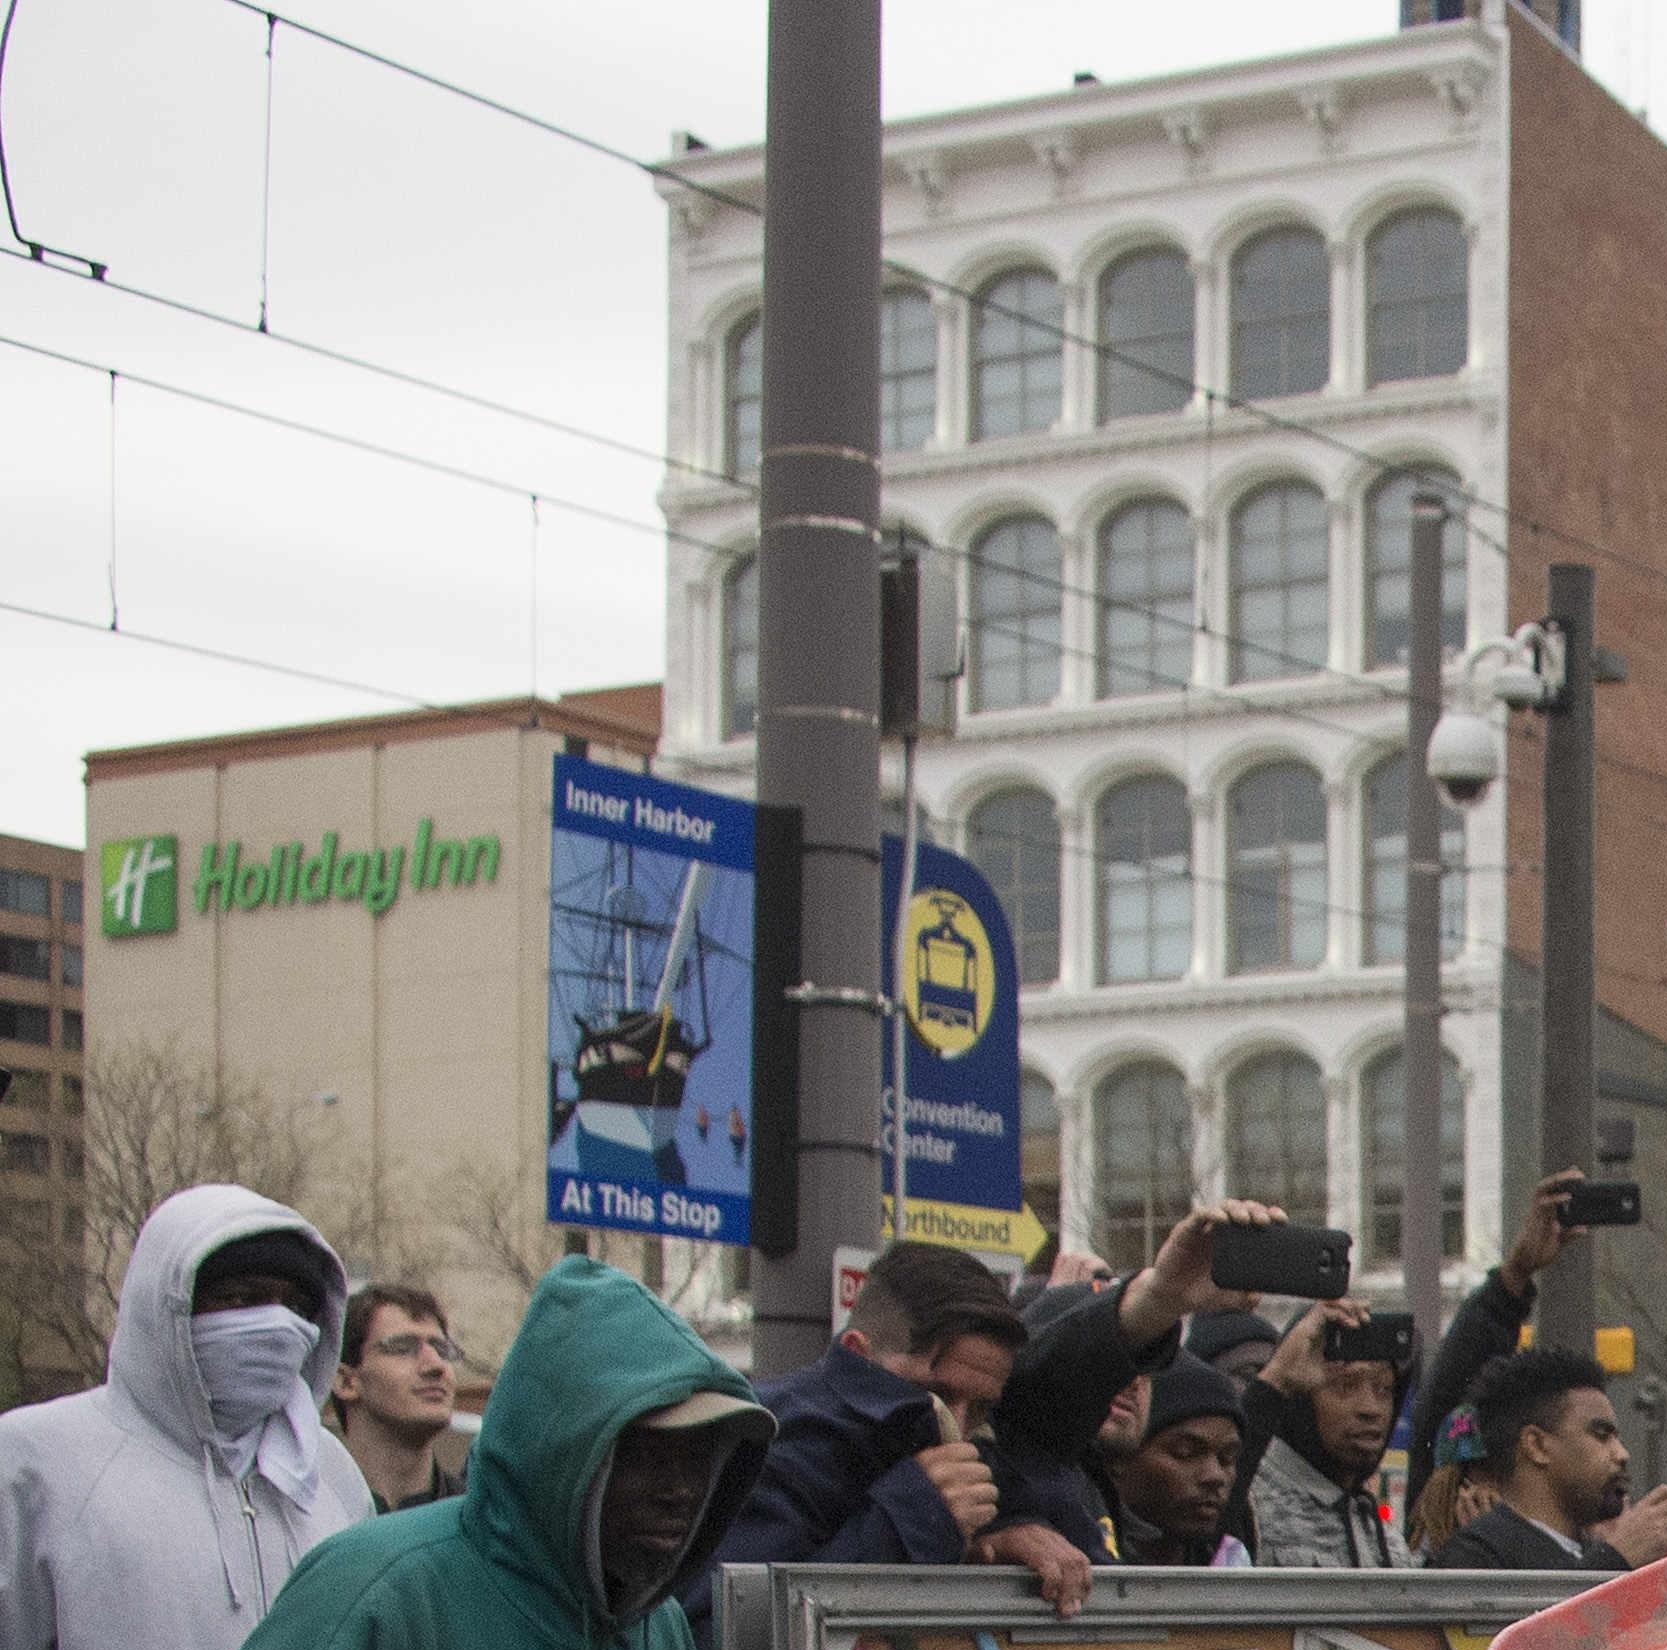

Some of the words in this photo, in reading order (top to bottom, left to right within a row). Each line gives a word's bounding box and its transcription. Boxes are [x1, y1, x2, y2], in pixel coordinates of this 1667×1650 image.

[565, 779, 629, 822] Inner
[633, 796, 716, 844] Harbor
[193, 830, 406, 918] Holiday
[410, 816, 500, 890] Inn
[560, 1178, 592, 1215] At
[597, 1182, 655, 1223] This
[661, 1190, 721, 1237] Stop
[882, 1202, 1010, 1243] Nrthbound
